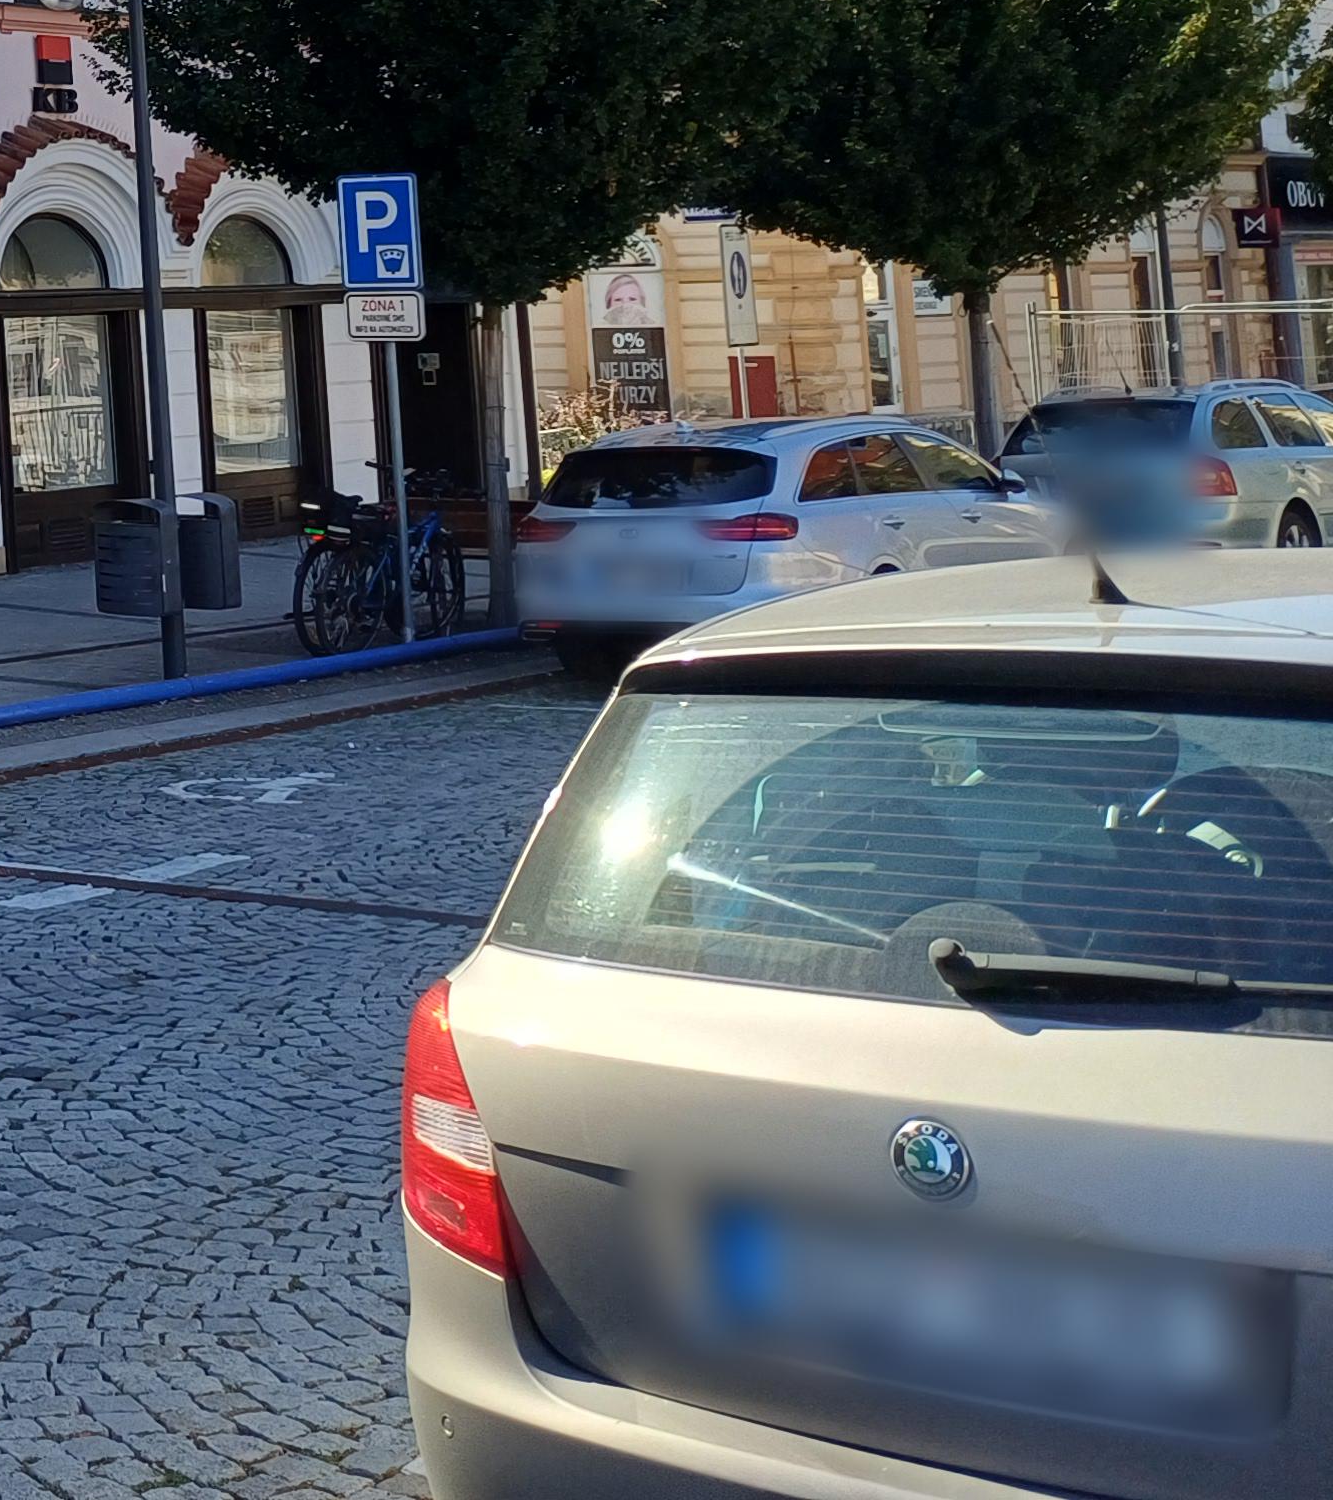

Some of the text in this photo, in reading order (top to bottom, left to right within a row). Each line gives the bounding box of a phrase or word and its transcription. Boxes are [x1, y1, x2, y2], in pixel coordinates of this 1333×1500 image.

[32, 87, 79, 113] KB
[355, 190, 398, 253] P
[399, 299, 405, 311] 1
[611, 332, 645, 349] 0%
[599, 358, 664, 381] NEJLEPŠÍ
[617, 385, 658, 404] URZY
